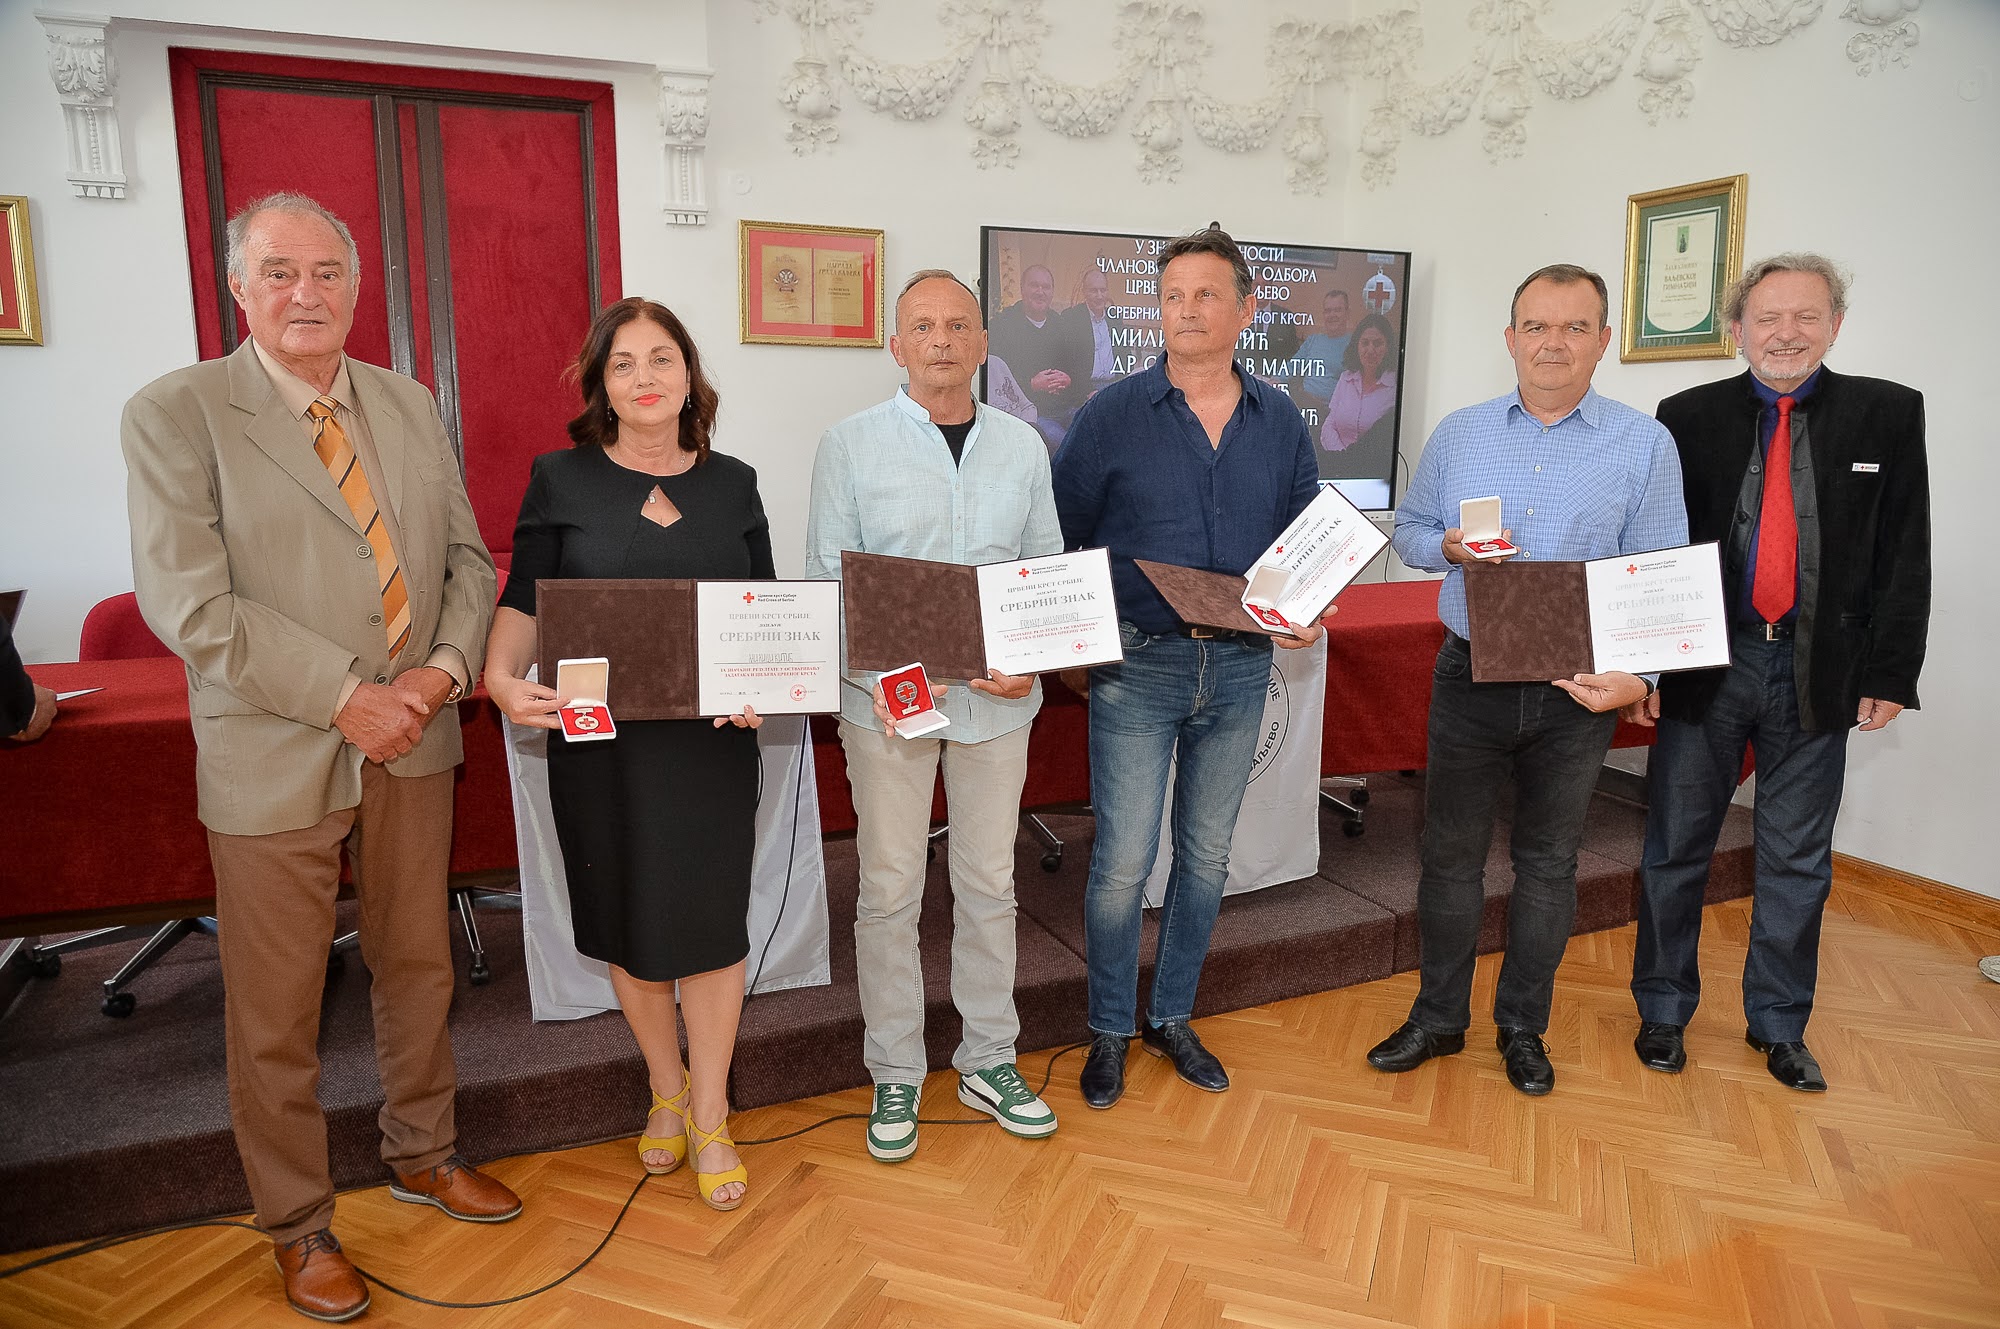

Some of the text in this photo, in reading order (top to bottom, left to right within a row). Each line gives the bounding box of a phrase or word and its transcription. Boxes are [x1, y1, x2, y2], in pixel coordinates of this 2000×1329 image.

[1135, 239, 1145, 254] У
[1239, 246, 1284, 262] НОСТИ
[1096, 257, 1159, 274] ЧЛАНОВ
[1262, 266, 1317, 283] ОДБОРА
[1126, 279, 1290, 302] ЦРВЕ ЉЕВО
[1249, 312, 1278, 325] НОГ
[1280, 312, 1314, 326] КРСТА
[1110, 355, 1136, 374] ДР
[1262, 358, 1325, 376] МАТИЋ
[1000, 592, 1095, 613] СРЕБРНИ ЗНАК
[1608, 591, 1704, 611] СРЕБРНИ ЗНАК
[720, 631, 820, 642] СРЕБРНИ ЗНАК
[1268, 678, 1280, 702] ИЈЕ
